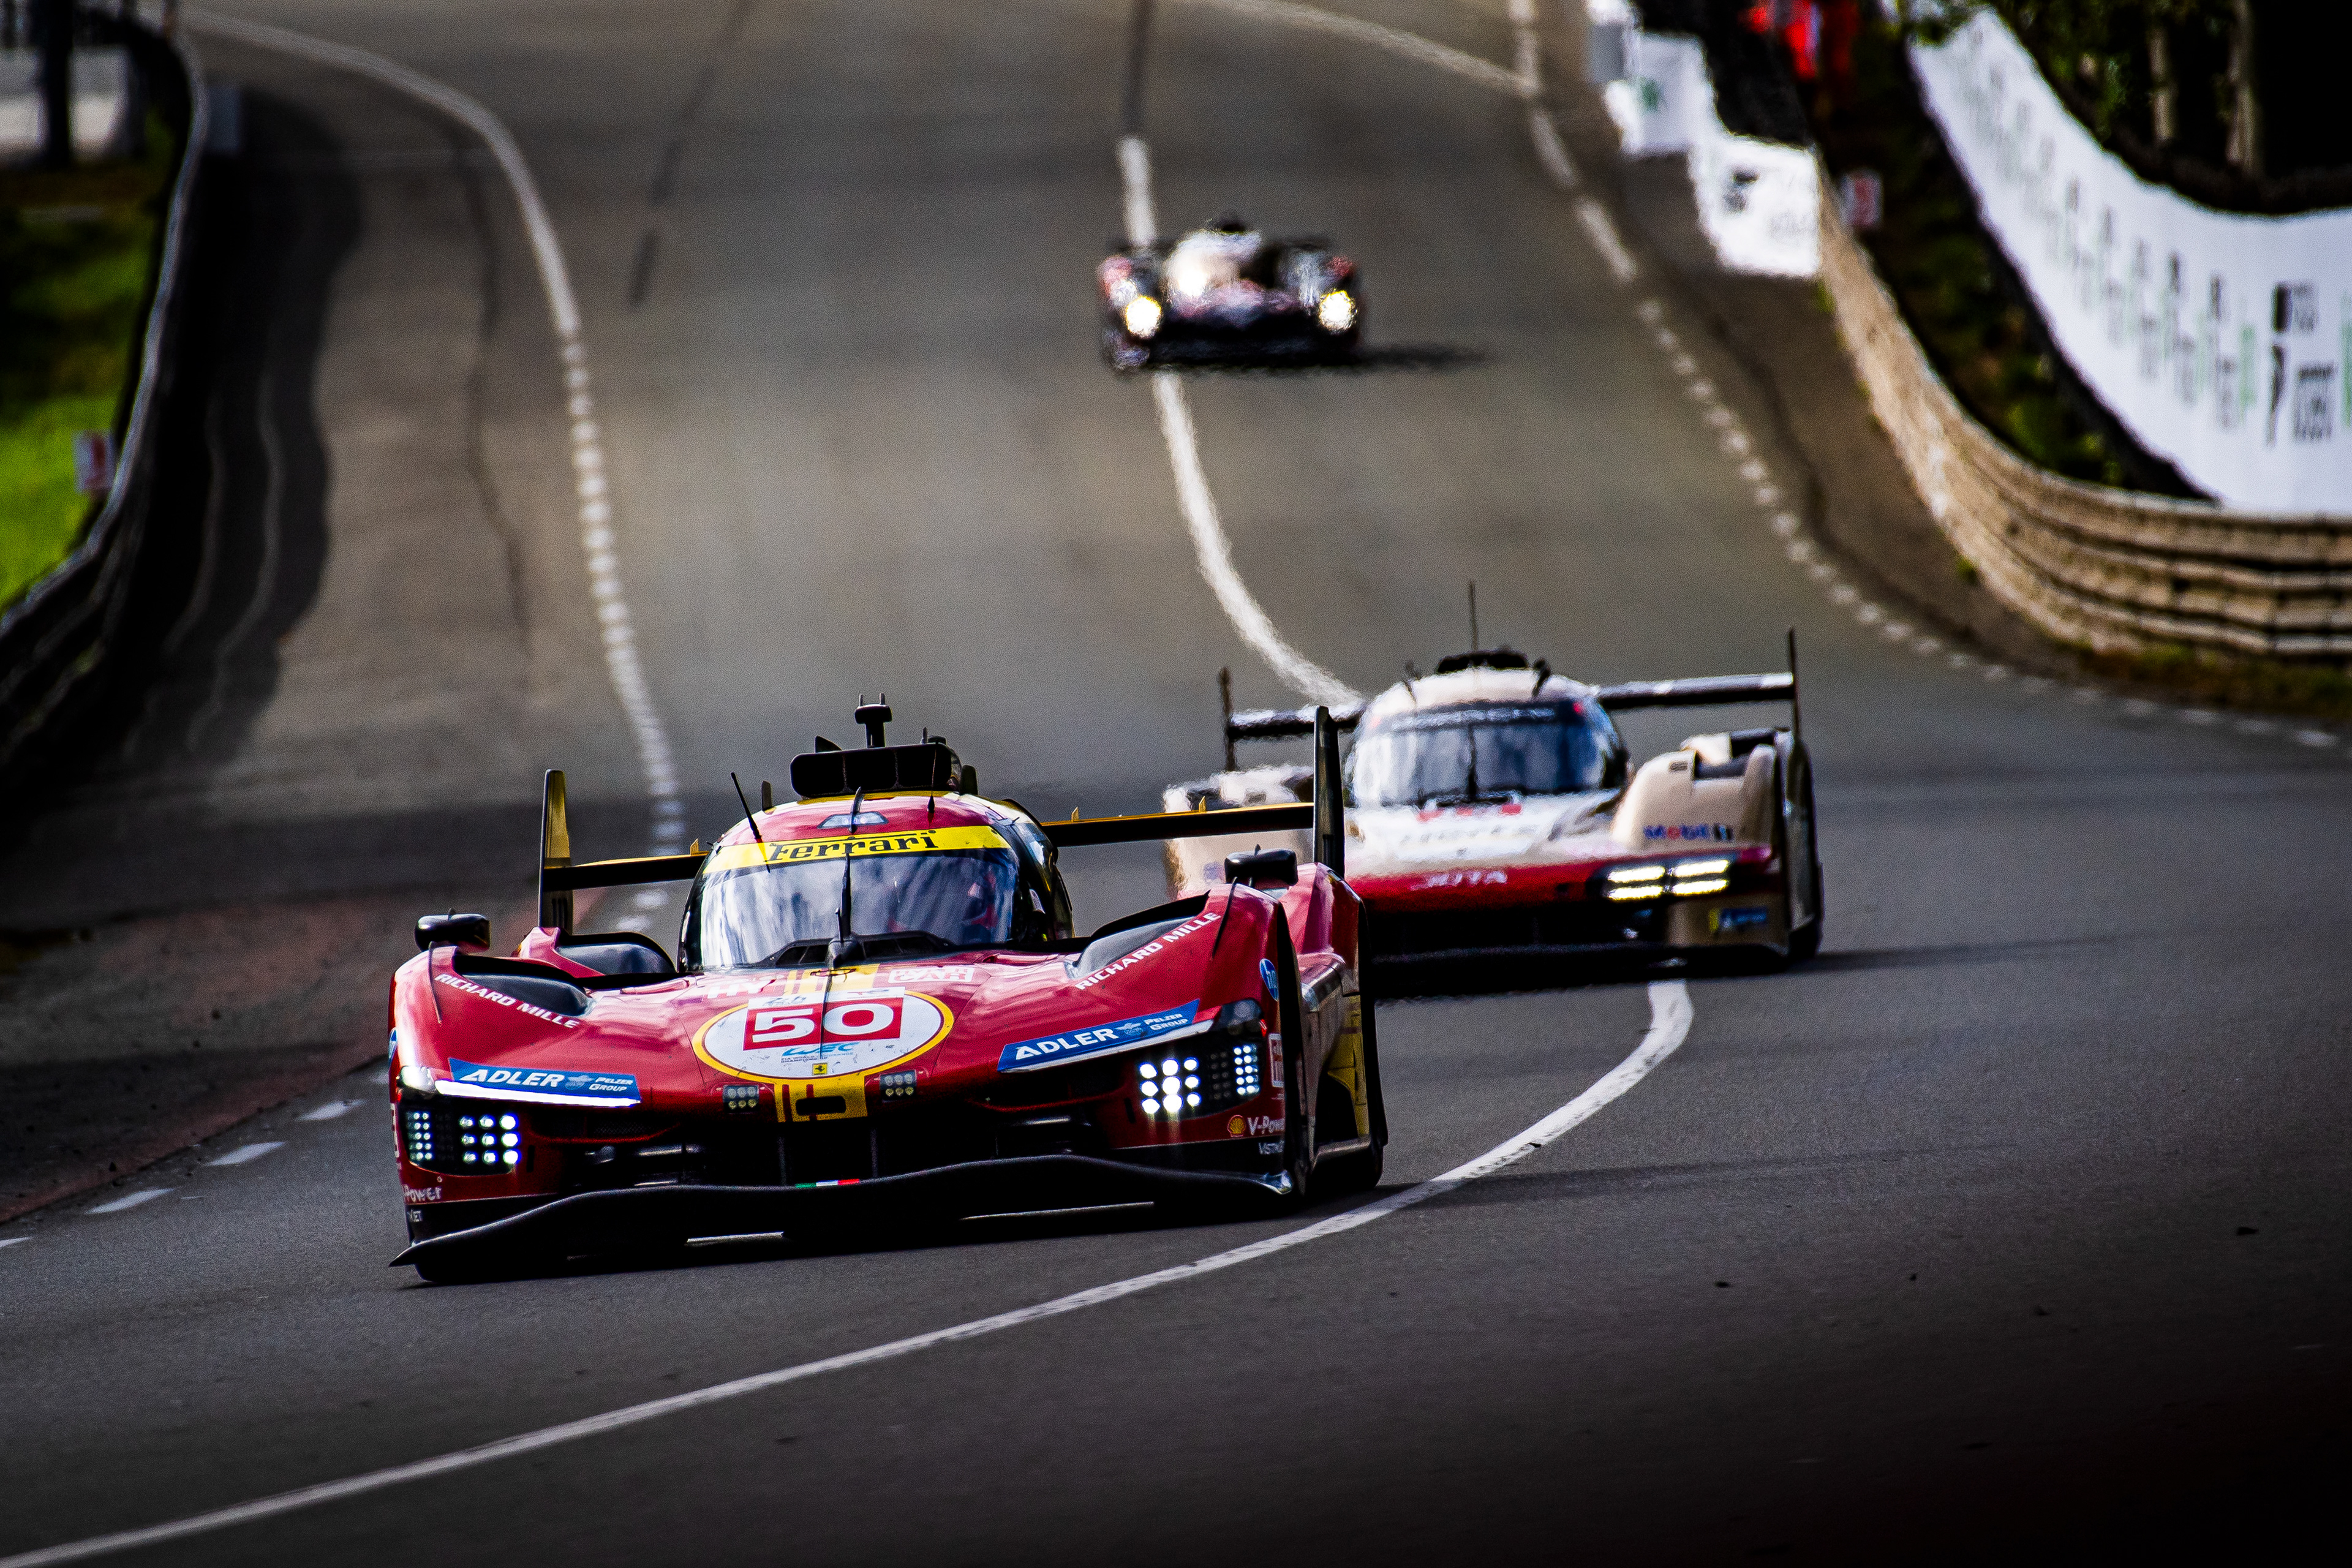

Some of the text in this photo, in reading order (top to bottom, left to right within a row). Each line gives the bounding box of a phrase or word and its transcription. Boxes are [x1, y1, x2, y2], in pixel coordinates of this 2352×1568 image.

[766, 830, 938, 862] Ferrari
[1075, 912, 1221, 990] RICHARD MILLE
[435, 973, 580, 1029] RICHARD MILLE
[752, 1003, 894, 1042] 50
[782, 1042, 859, 1056] WEC
[1016, 1028, 1119, 1060] ADLER
[459, 1069, 565, 1087] ADLER
